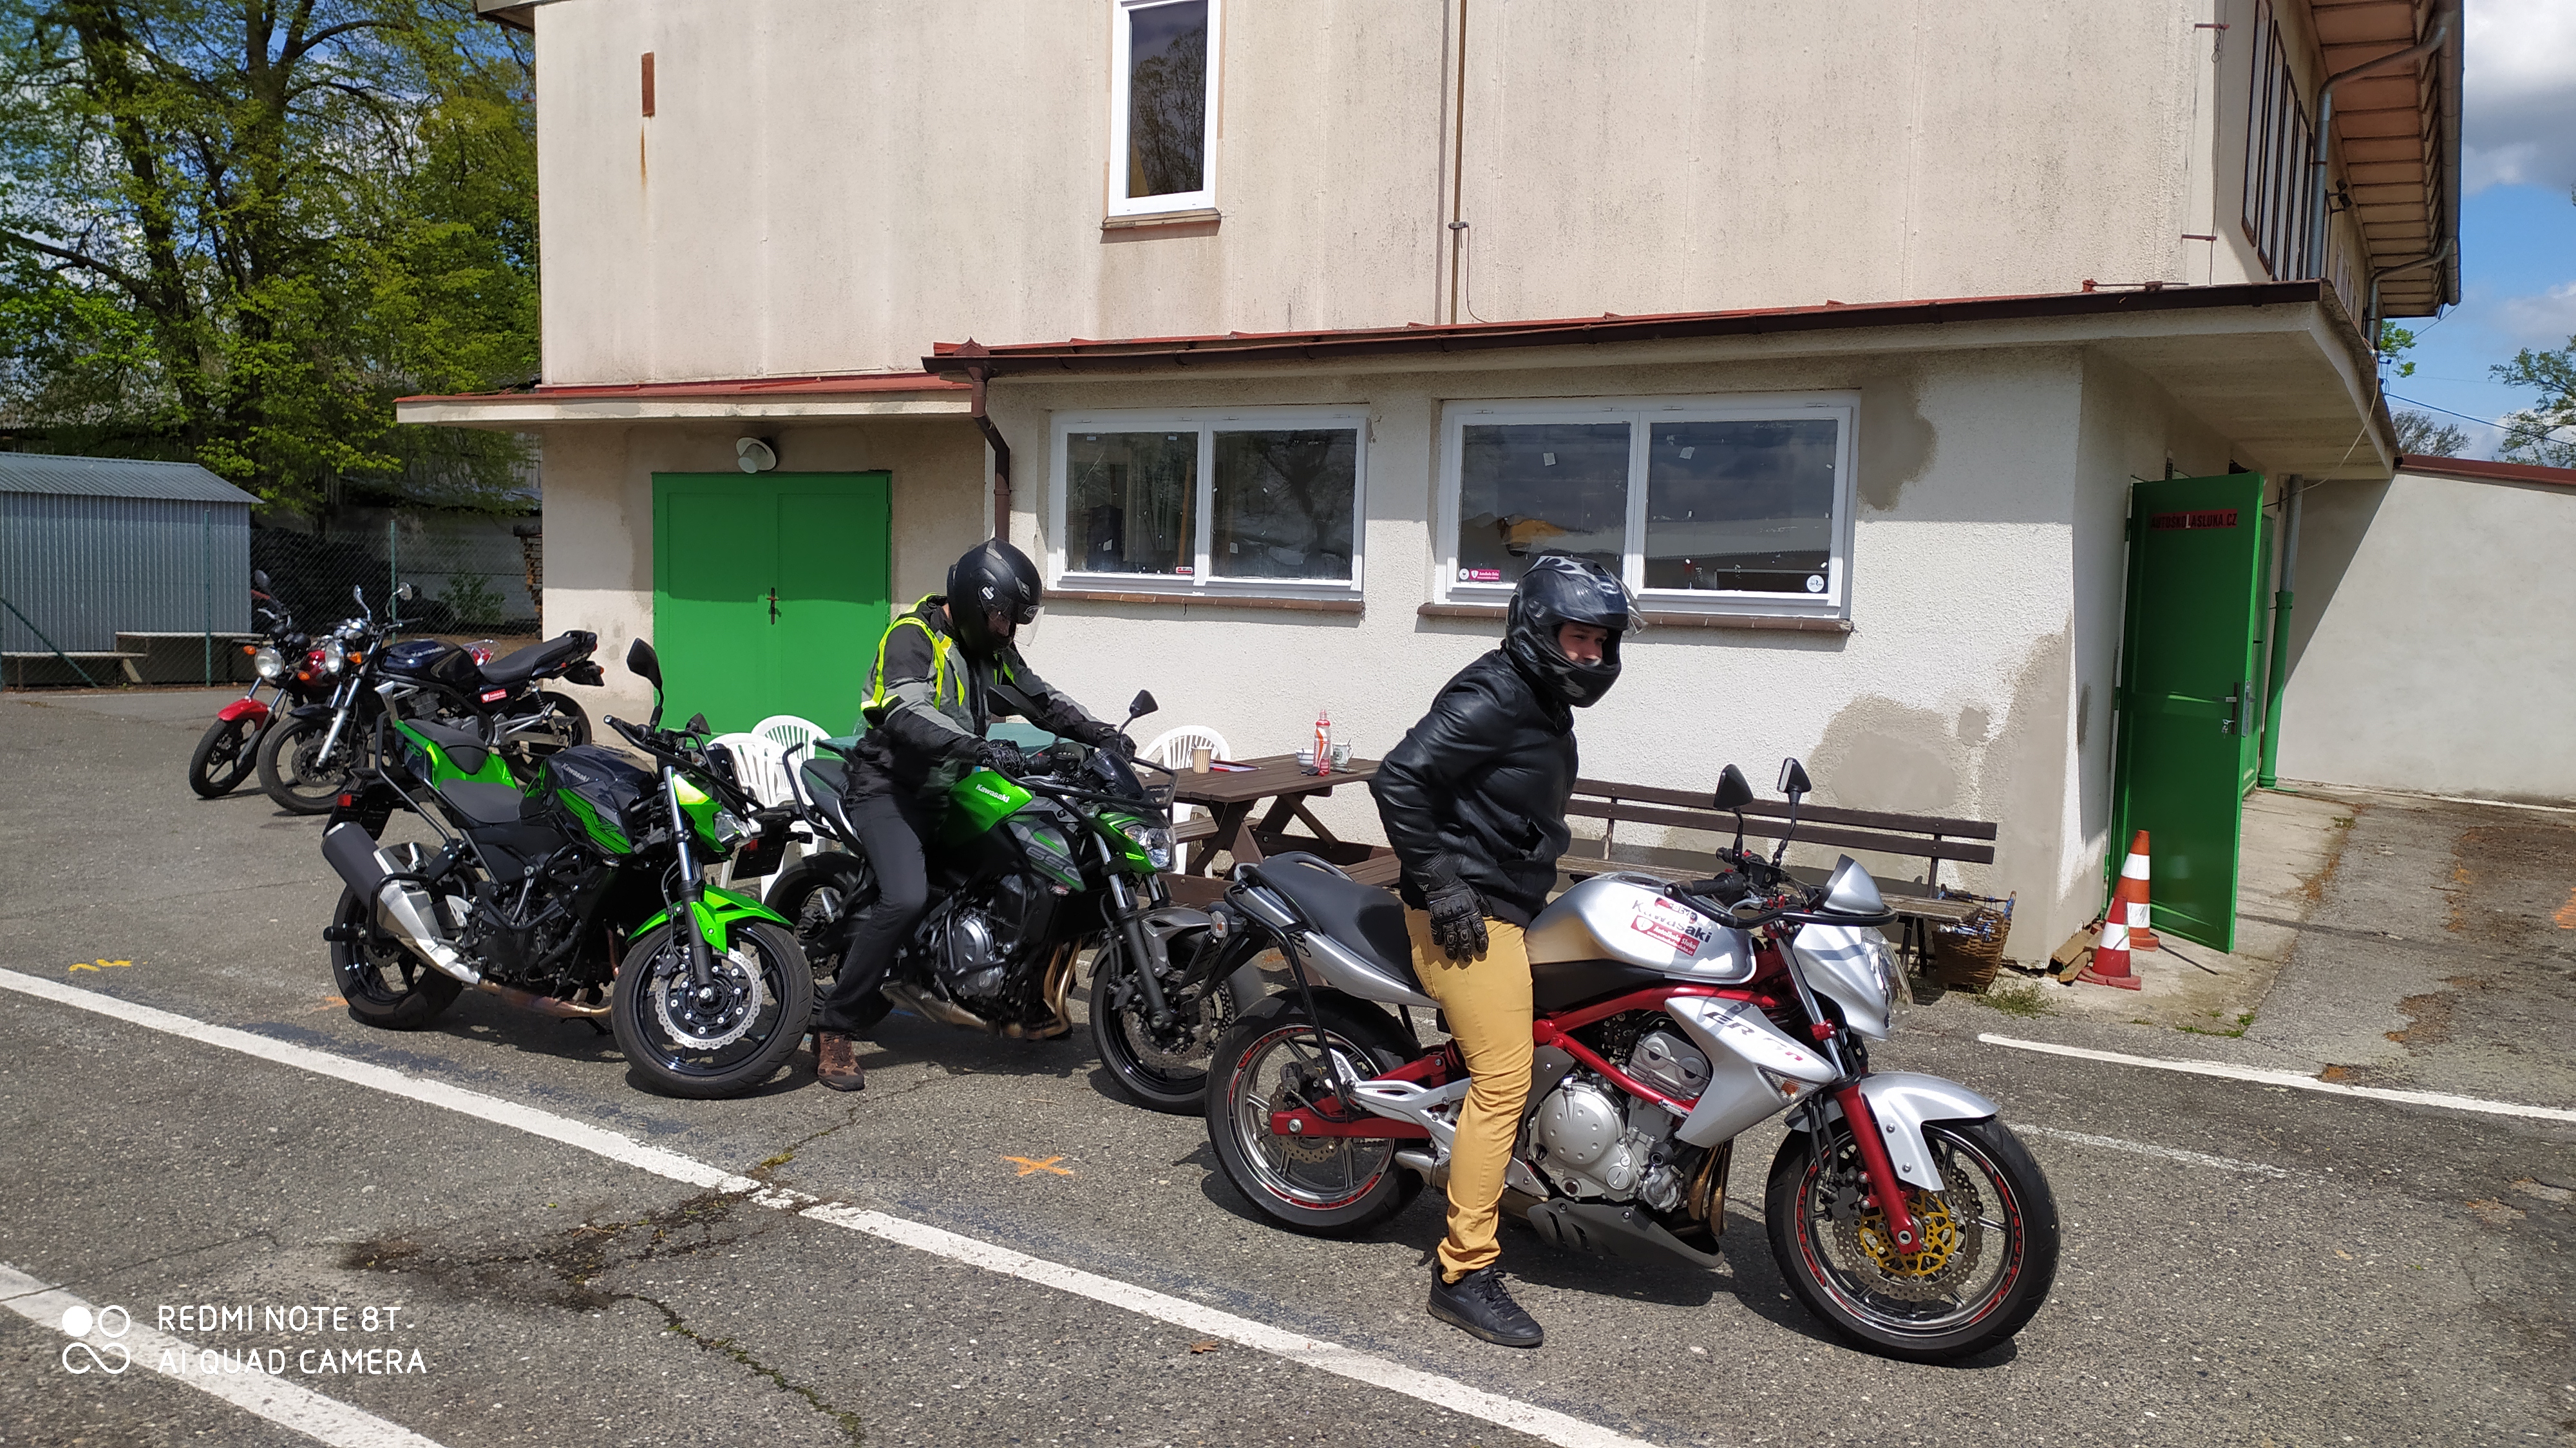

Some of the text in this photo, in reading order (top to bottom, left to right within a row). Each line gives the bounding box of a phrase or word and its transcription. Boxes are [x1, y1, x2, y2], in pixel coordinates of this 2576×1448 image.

[561, 763, 591, 783] Kawasaki
[975, 783, 1010, 803] Kawasaki
[1632, 899, 1713, 944] Kawasaki
[1680, 938, 1697, 950] Sluka
